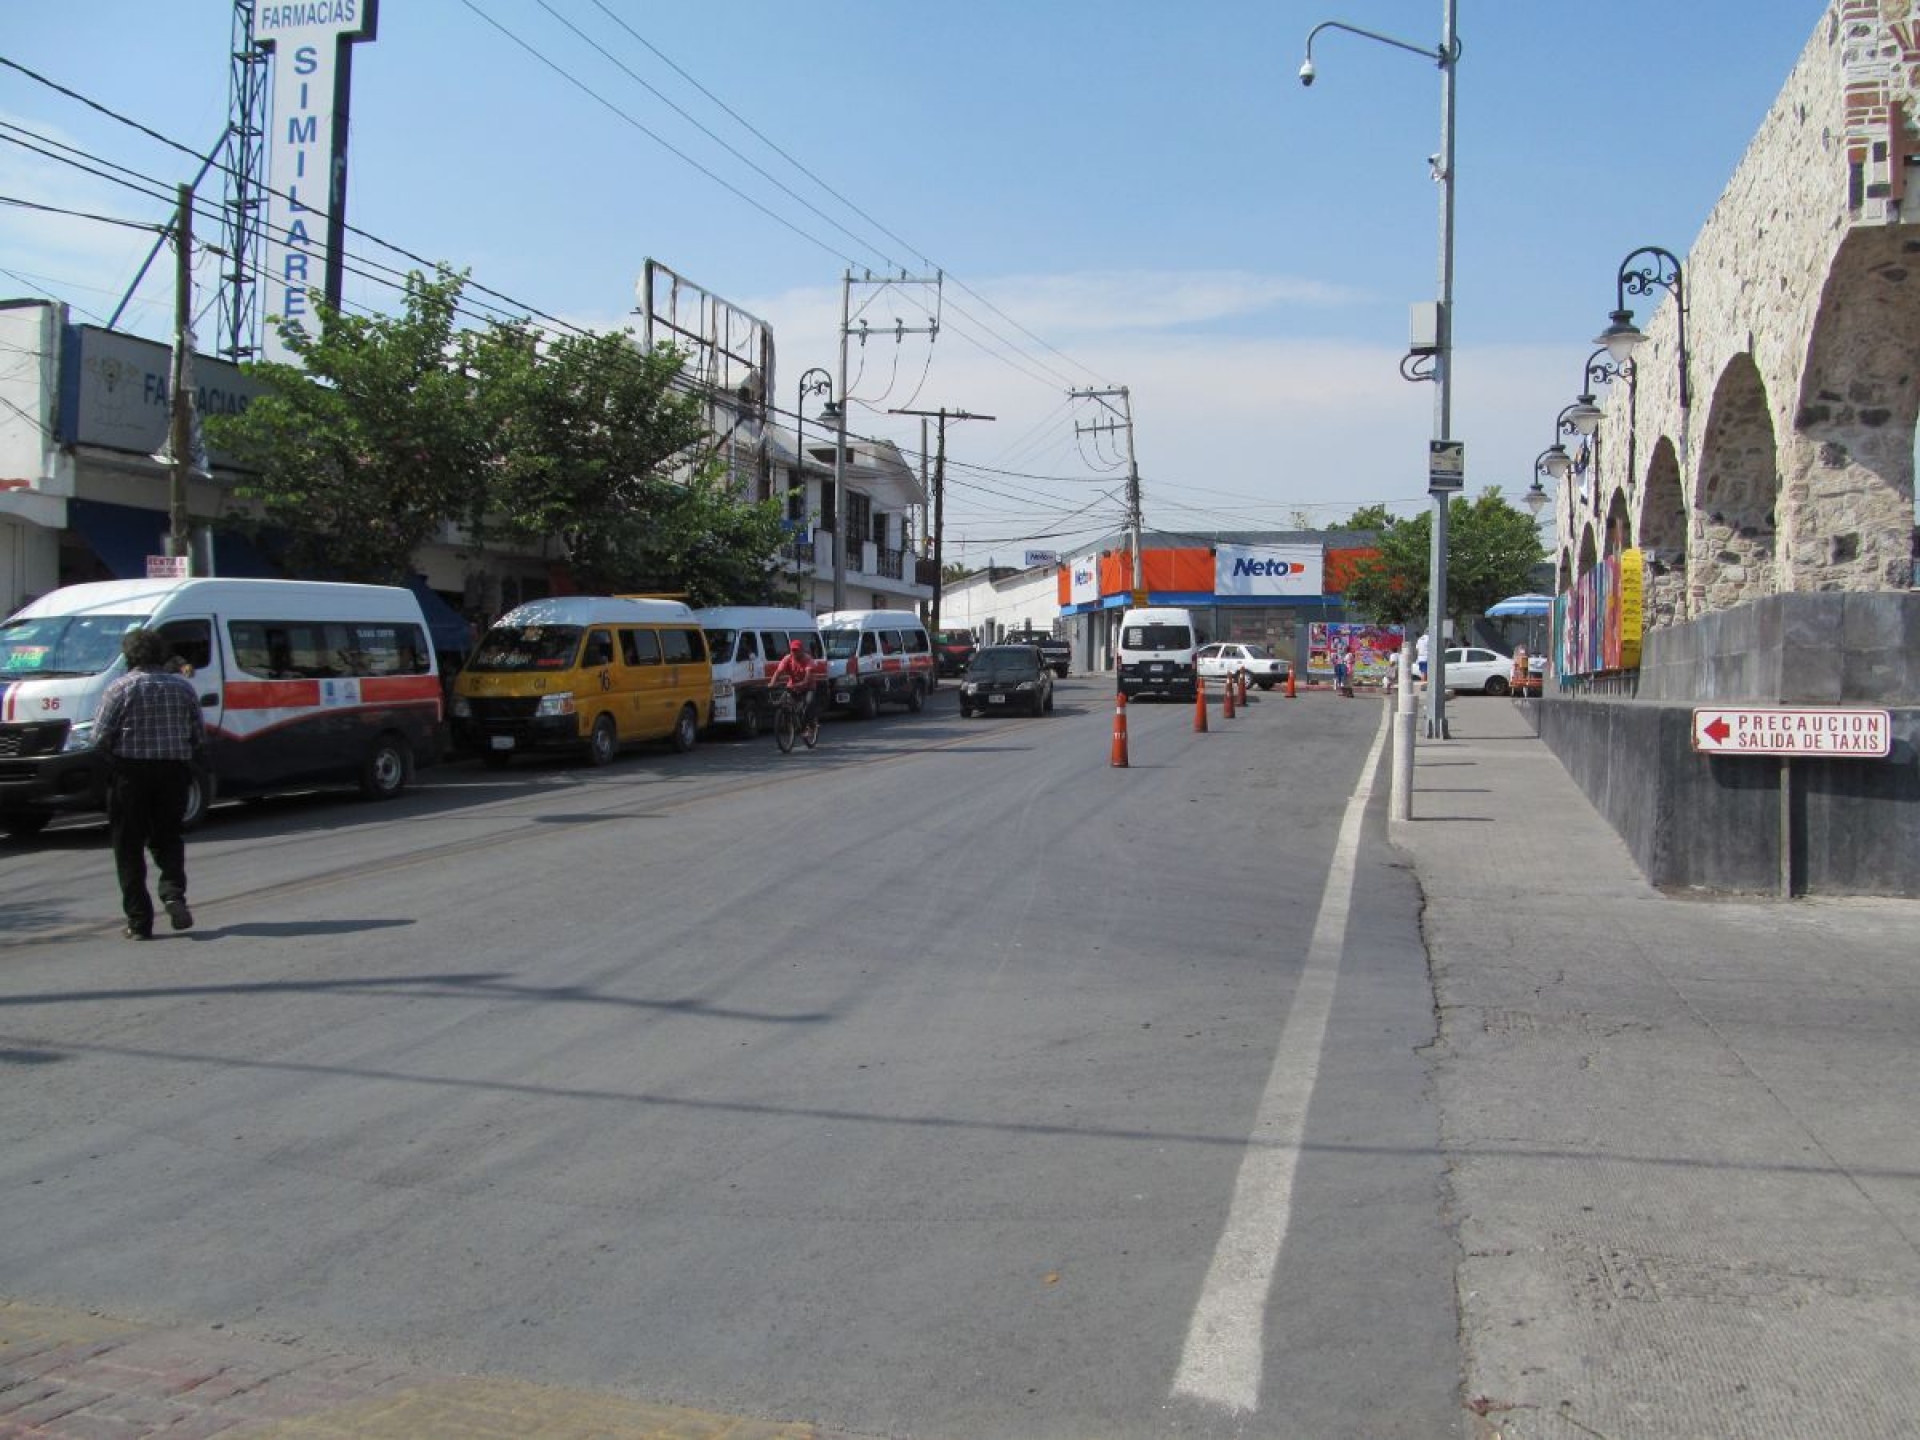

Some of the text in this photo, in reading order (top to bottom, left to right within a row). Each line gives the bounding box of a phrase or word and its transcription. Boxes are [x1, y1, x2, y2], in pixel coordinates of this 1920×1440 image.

[261, 0, 355, 29] FARMACIAS
[1233, 557, 1289, 577] Neto
[41, 698, 60, 710] 36
[1739, 715, 1878, 732] PRECAUCION
[1739, 731, 1878, 749] SALIDA DE TAXIS
